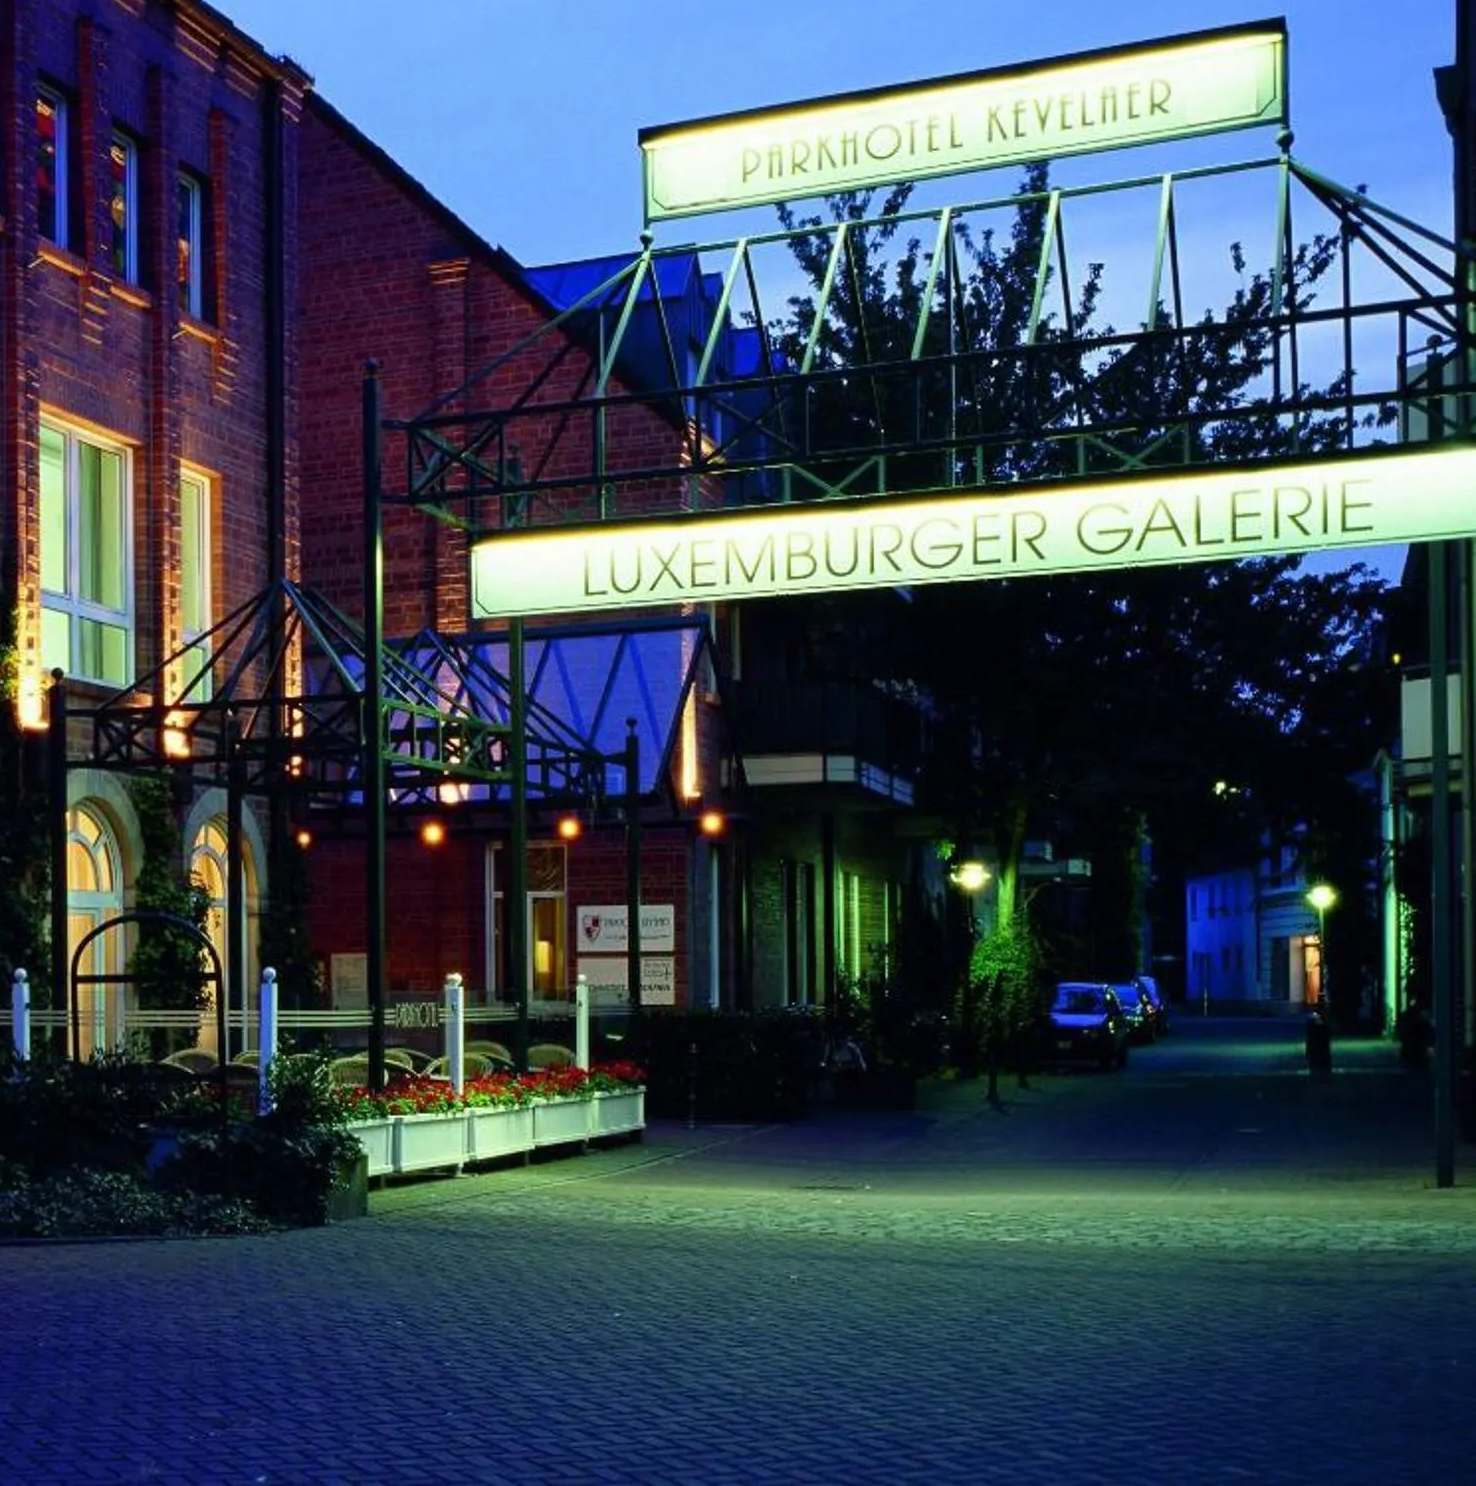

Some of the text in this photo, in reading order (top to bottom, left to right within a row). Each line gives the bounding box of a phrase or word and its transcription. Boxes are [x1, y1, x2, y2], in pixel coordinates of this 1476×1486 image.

[741, 79, 1172, 183] PARKHOTEL KEVELAER
[583, 479, 1373, 596] LUXEMBURGER GALERIE
